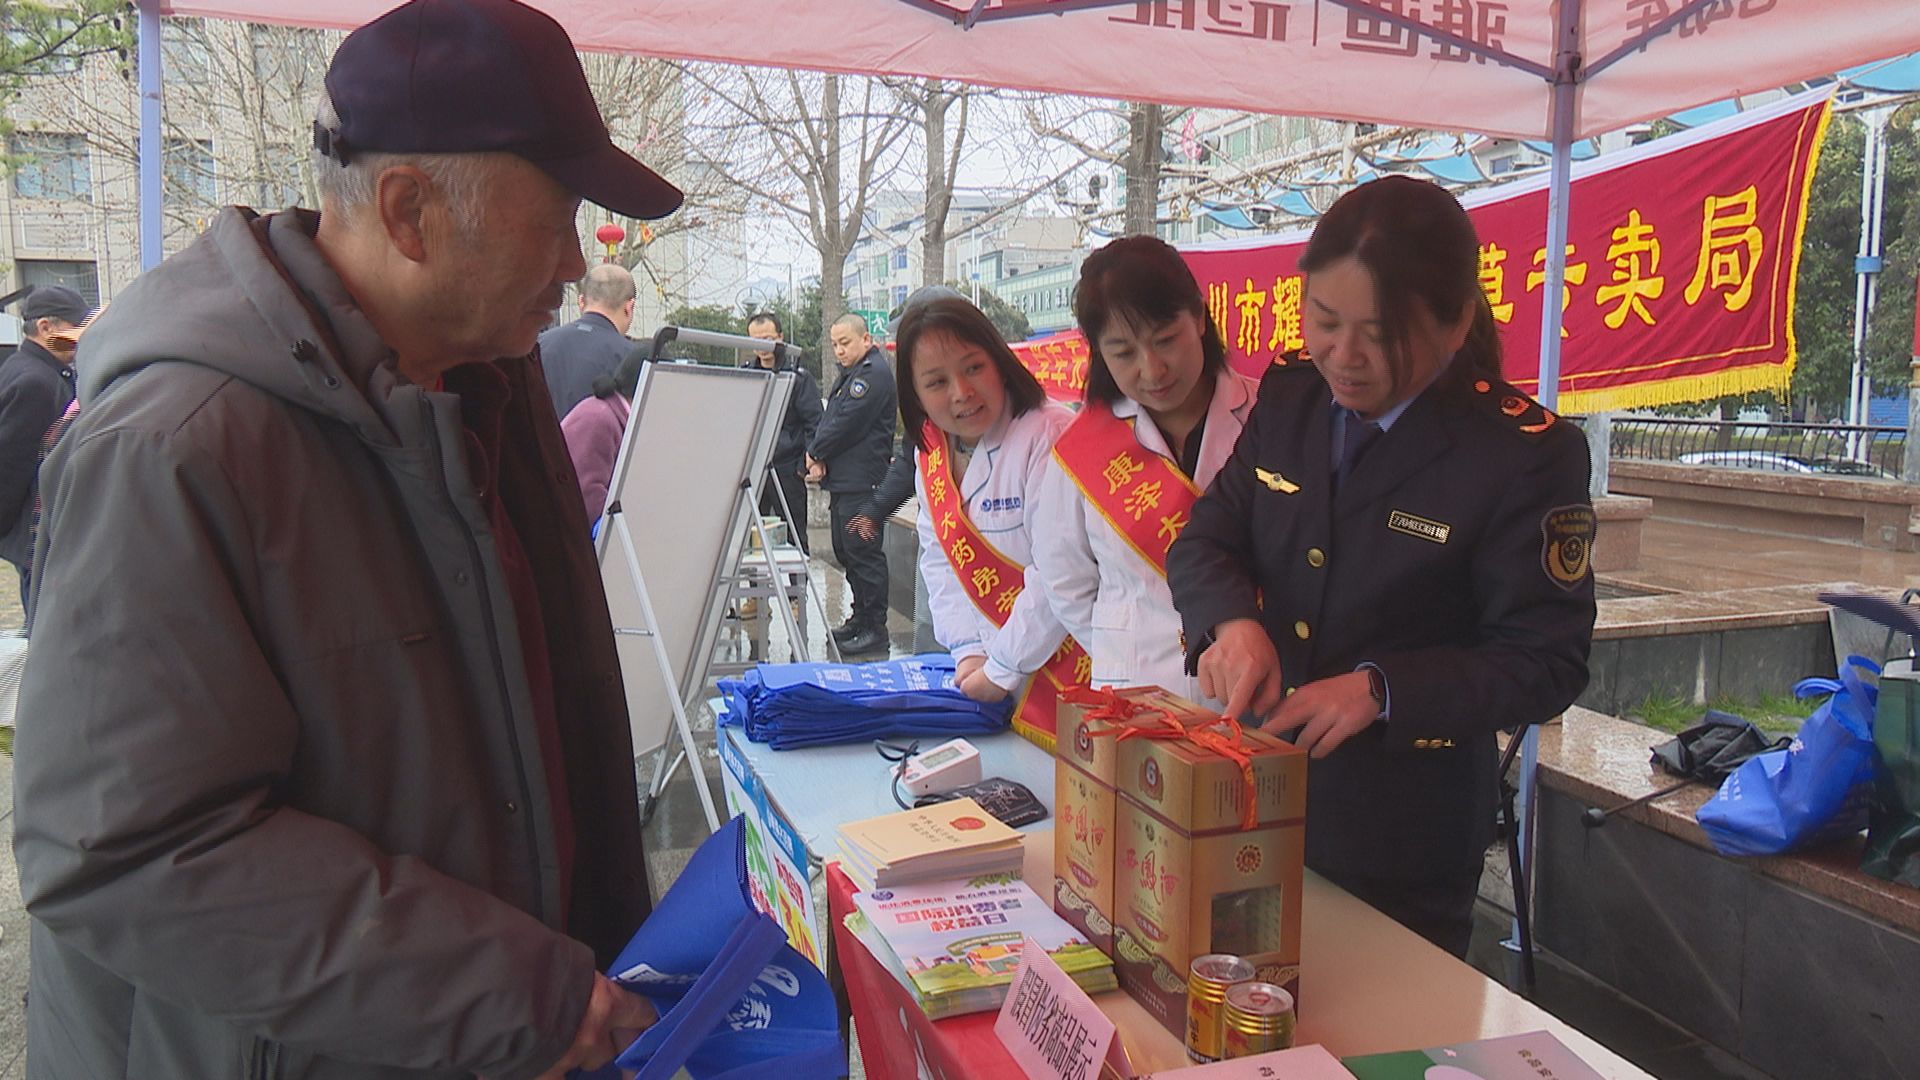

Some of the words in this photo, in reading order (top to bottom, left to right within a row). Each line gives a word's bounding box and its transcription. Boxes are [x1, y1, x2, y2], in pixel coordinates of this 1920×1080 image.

[1145, 761, 1157, 786] 6
[929, 912, 1008, 934] 权益日
